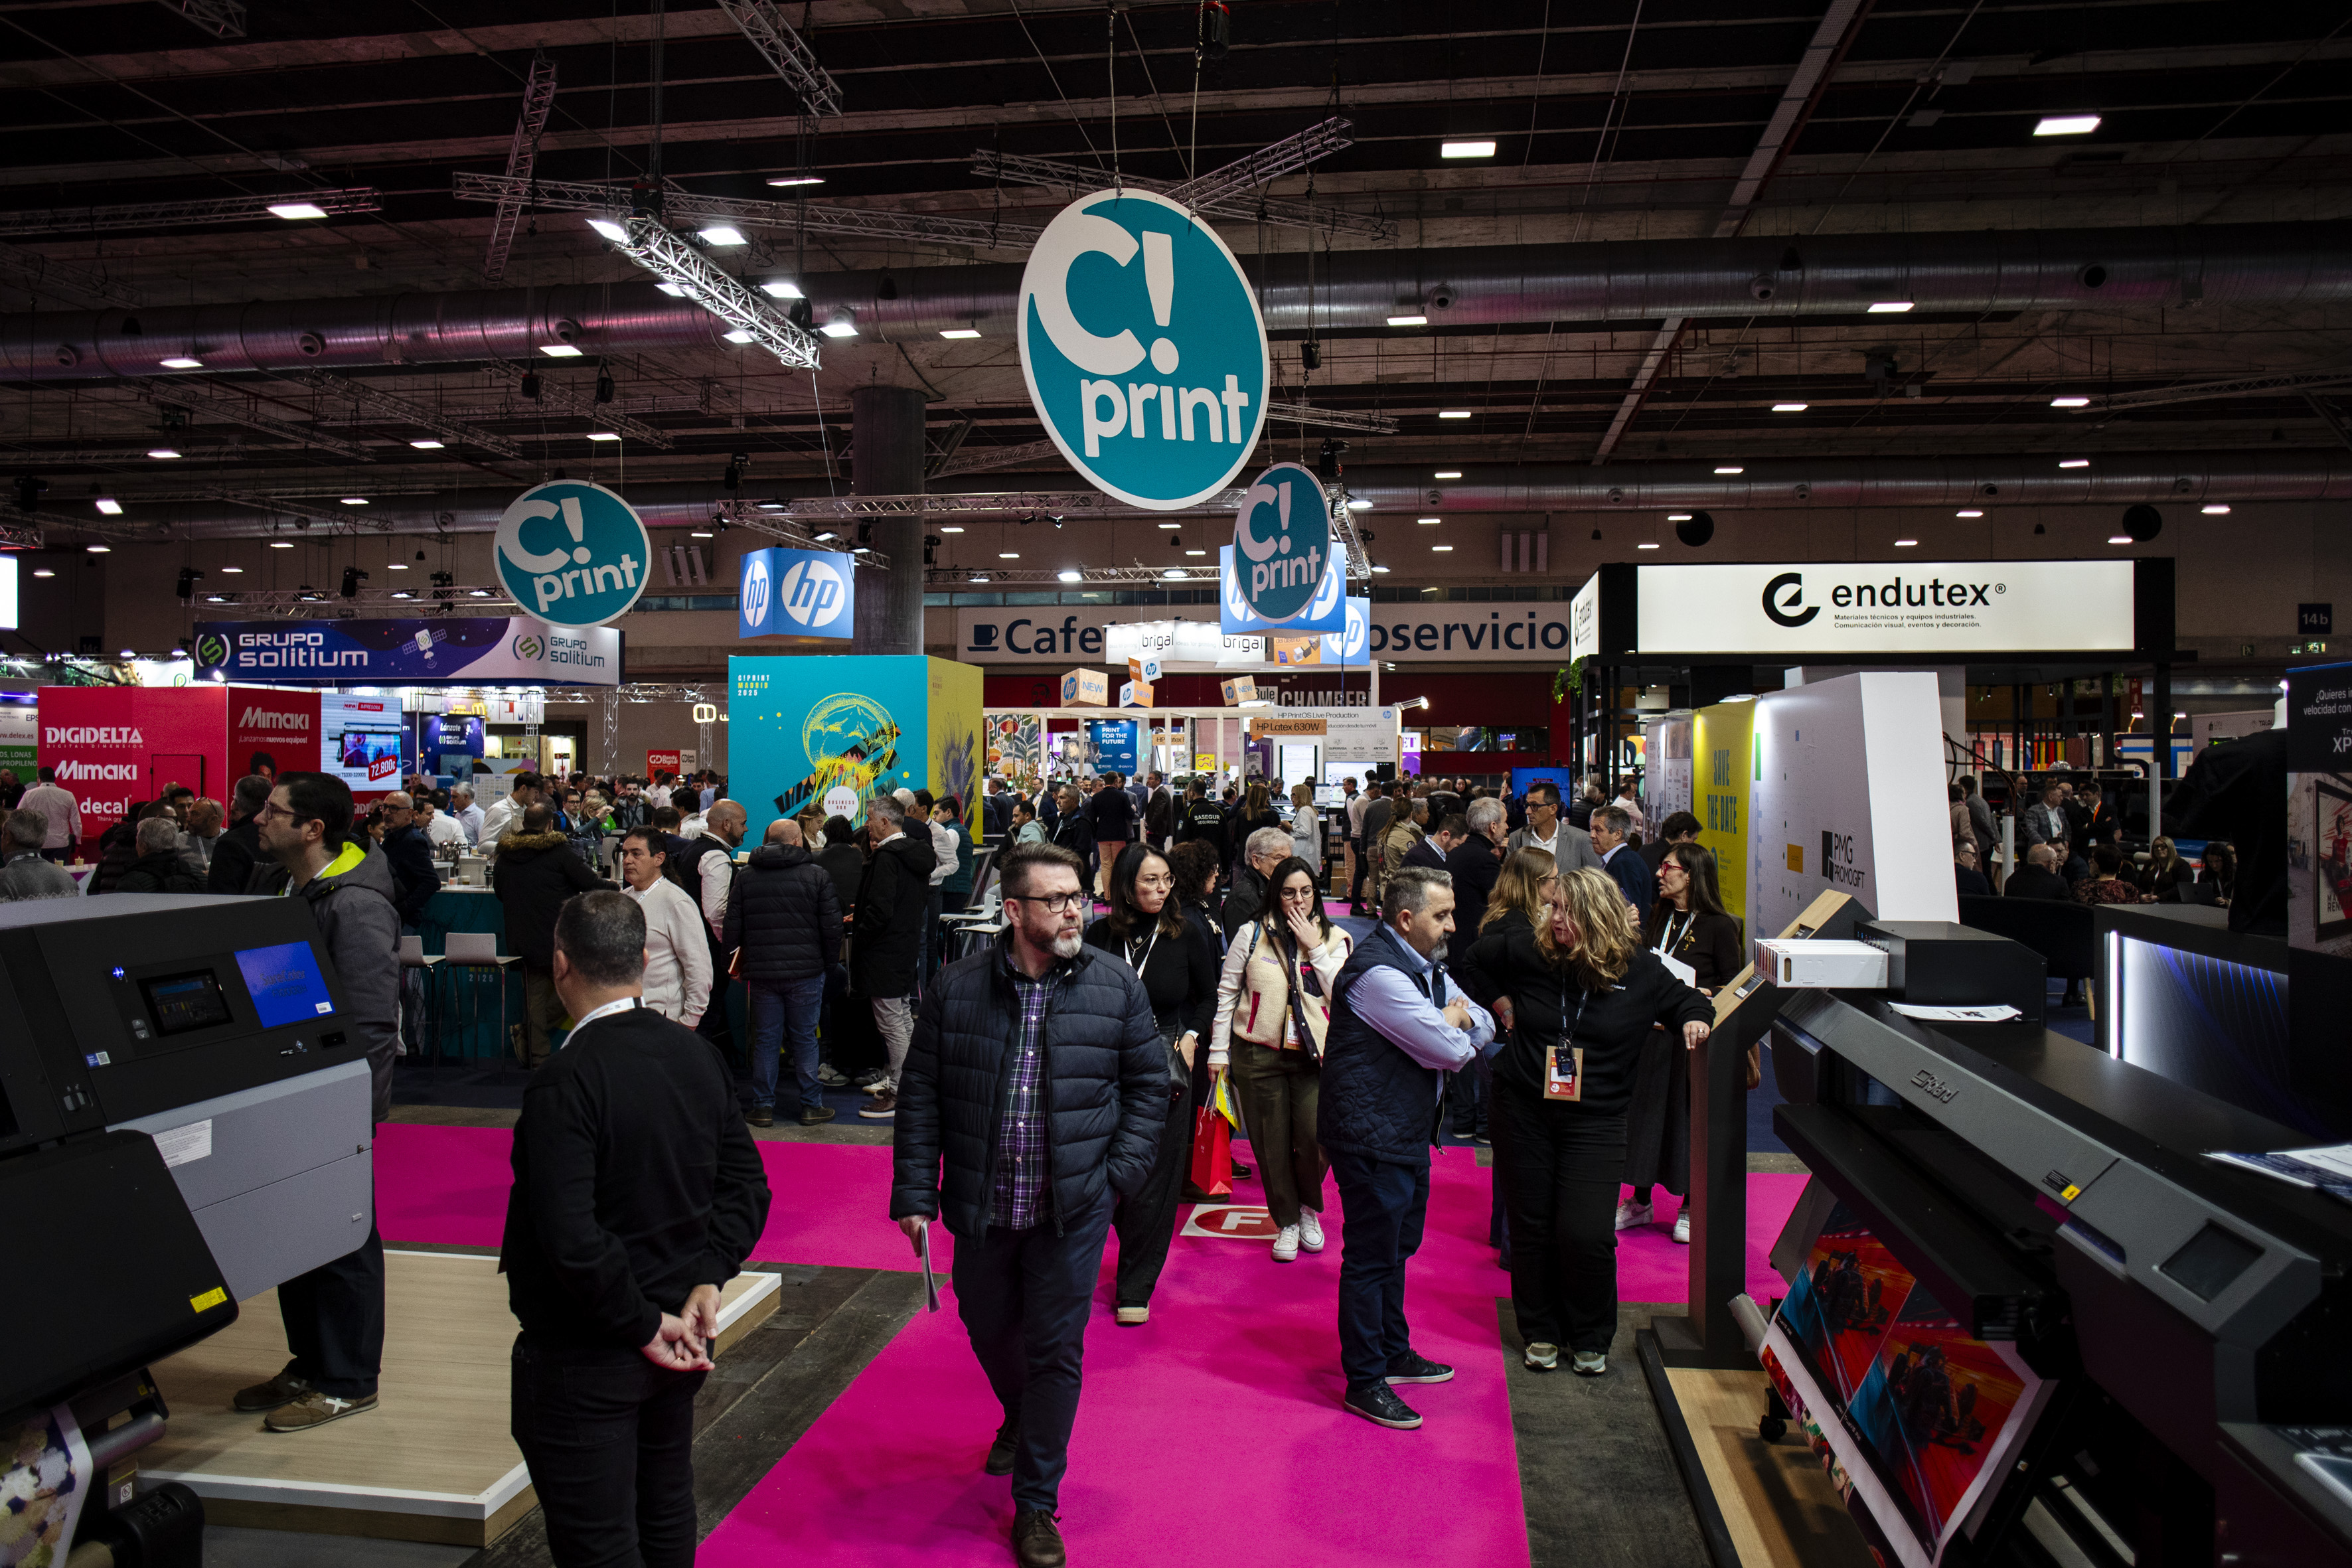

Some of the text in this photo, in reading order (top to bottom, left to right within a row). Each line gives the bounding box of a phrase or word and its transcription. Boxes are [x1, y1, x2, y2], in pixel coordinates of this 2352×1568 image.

[1080, 374, 1249, 457] print
[533, 554, 639, 613] print
[1252, 546, 1320, 603] print
[745, 560, 768, 627] hp
[789, 560, 841, 627] hp
[239, 633, 324, 647] GRUPO
[550, 636, 588, 650] GRUPO
[1005, 616, 1103, 655] Cafe
[1142, 631, 1174, 651] brigal
[1223, 633, 1263, 653] brigal
[239, 647, 368, 666] solitium
[550, 649, 605, 668] solitium
[1130, 665, 1140, 674] NEW
[1146, 663, 1156, 676] hp
[1063, 676, 1077, 700] hp
[1082, 681, 1103, 693] NEW
[1136, 689, 1150, 699] NEW
[1238, 684, 1253, 693] NEW
[238, 706, 309, 730] Mimaki
[2303, 705, 2352, 716] velocidad con
[45, 727, 143, 744] DIGIDELTA
[285, 736, 307, 745] equipos!
[55, 760, 137, 780] Mimaki
[370, 758, 396, 777] 72.800€
[1713, 749, 1730, 786] SAVE
[80, 797, 129, 815] decal
[1707, 794, 1718, 830] THE
[1720, 795, 1737, 834] DATE
[1834, 832, 1853, 865] PMG
[1834, 863, 1865, 889] PROMOGIFT
[1221, 1211, 1269, 1230] F
